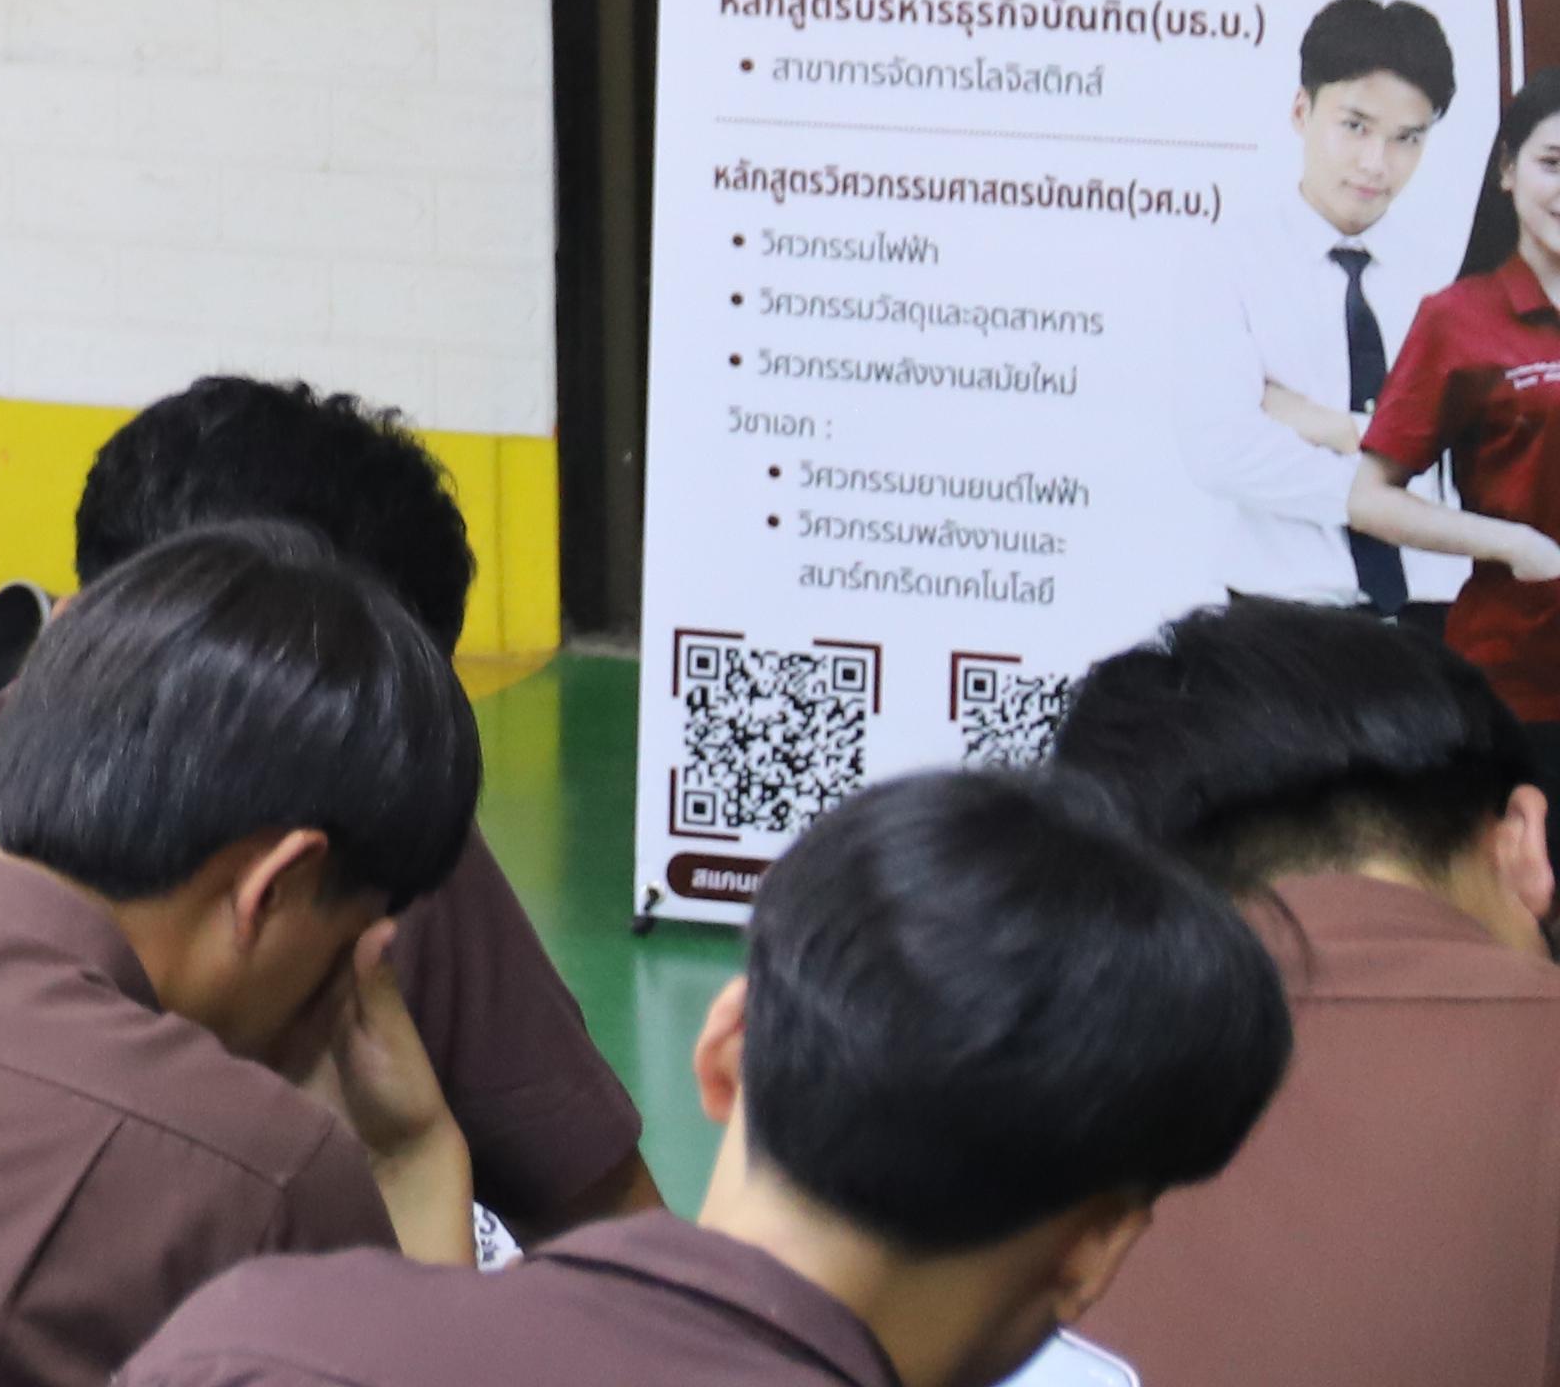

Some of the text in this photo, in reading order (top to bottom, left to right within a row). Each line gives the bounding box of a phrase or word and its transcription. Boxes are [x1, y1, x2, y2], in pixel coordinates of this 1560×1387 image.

[770, 52, 1104, 98] สาขาการจัดการโลจิสติกส์
[713, 160, 1223, 222] หลักสูตรวิศวกรรมศาสตรบัณฑิต(วศ.บ.)
[759, 228, 940, 265] วิศวกรรมไฟฟ้า
[758, 287, 1105, 337] วิศวกรรมวัสดุและอุตสาหการ
[757, 347, 1078, 396] วิศวกรรมพลังงานสมัยใหม่
[728, 406, 816, 438] วิชาเอก
[798, 459, 1090, 508] วิศวกรรมยานยนต์ไฟฟ้า
[797, 510, 1067, 556] วิศวกรรมพลังงานและ
[798, 561, 1056, 606] สมาร์ทกริดเทคโนโลยี
